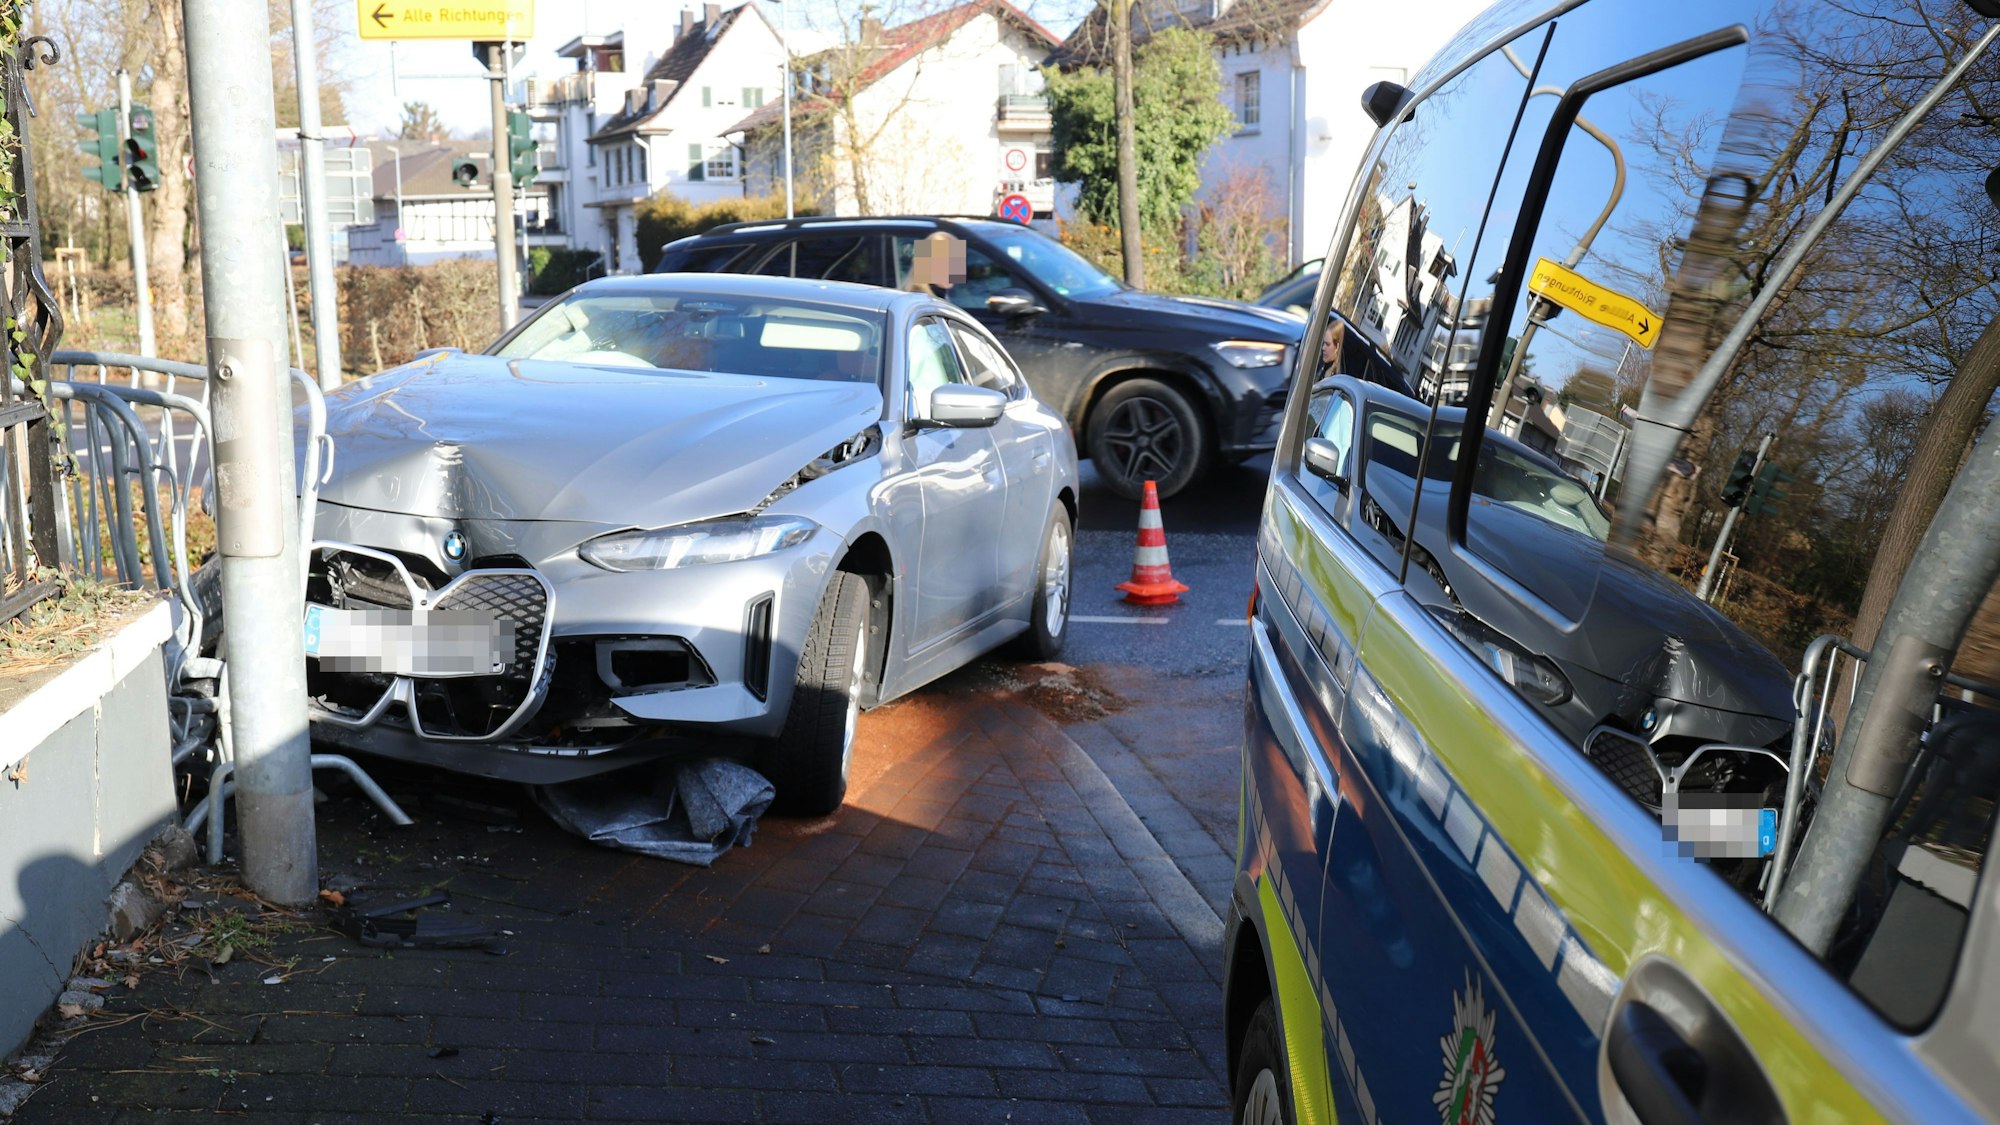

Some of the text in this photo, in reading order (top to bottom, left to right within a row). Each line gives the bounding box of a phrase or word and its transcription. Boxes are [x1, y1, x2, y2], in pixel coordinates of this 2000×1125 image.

[403, 8, 524, 24] Alle Richtungen
[308, 634, 317, 645] D
